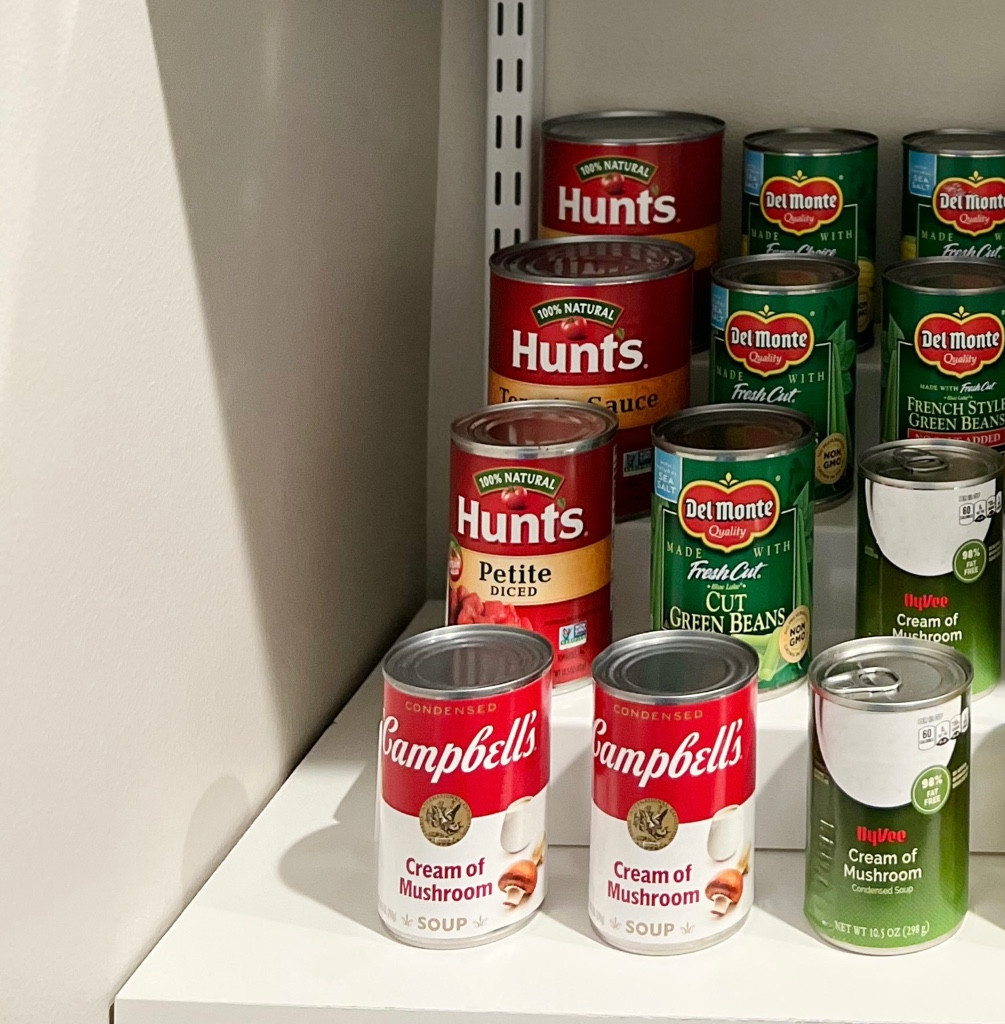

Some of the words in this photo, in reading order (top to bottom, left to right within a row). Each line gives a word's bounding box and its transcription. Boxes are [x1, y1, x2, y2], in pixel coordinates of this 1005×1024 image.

[538, 304, 562, 319] 100%
[564, 303, 614, 320] NATURAL
[731, 327, 752, 346] Del
[755, 331, 807, 348] Monte
[907, 397, 964, 415] FRENCH
[909, 412, 956, 430] GREEN
[960, 413, 1005, 431] BEANS
[686, 499, 713, 518] Del
[715, 500, 773, 521] Monte
[667, 541, 702, 558] MADE
[753, 541, 790, 557] WITH
[479, 561, 551, 583] Petite
[490, 586, 537, 597] DICED
[706, 591, 747, 612] CUT
[670, 606, 724, 633] GREEN
[729, 608, 785, 634] BEANS
[405, 701, 496, 716] CONDENSED
[380, 710, 537, 783] Campbell's
[593, 718, 743, 788] Campbell's
[924, 796, 941, 806] FREE
[926, 788, 938, 797] FAT
[406, 858, 461, 878] Cream
[466, 857, 485, 876] of
[613, 861, 669, 883] Cream
[674, 861, 692, 881] of
[844, 864, 922, 883] Mushroom
[399, 877, 493, 901] Mushroom
[608, 881, 700, 906] Mushroom
[852, 884, 893, 895] Condensed
[895, 885, 913, 895] Soup
[417, 917, 467, 932] SOUP
[625, 921, 675, 936] SOUP
